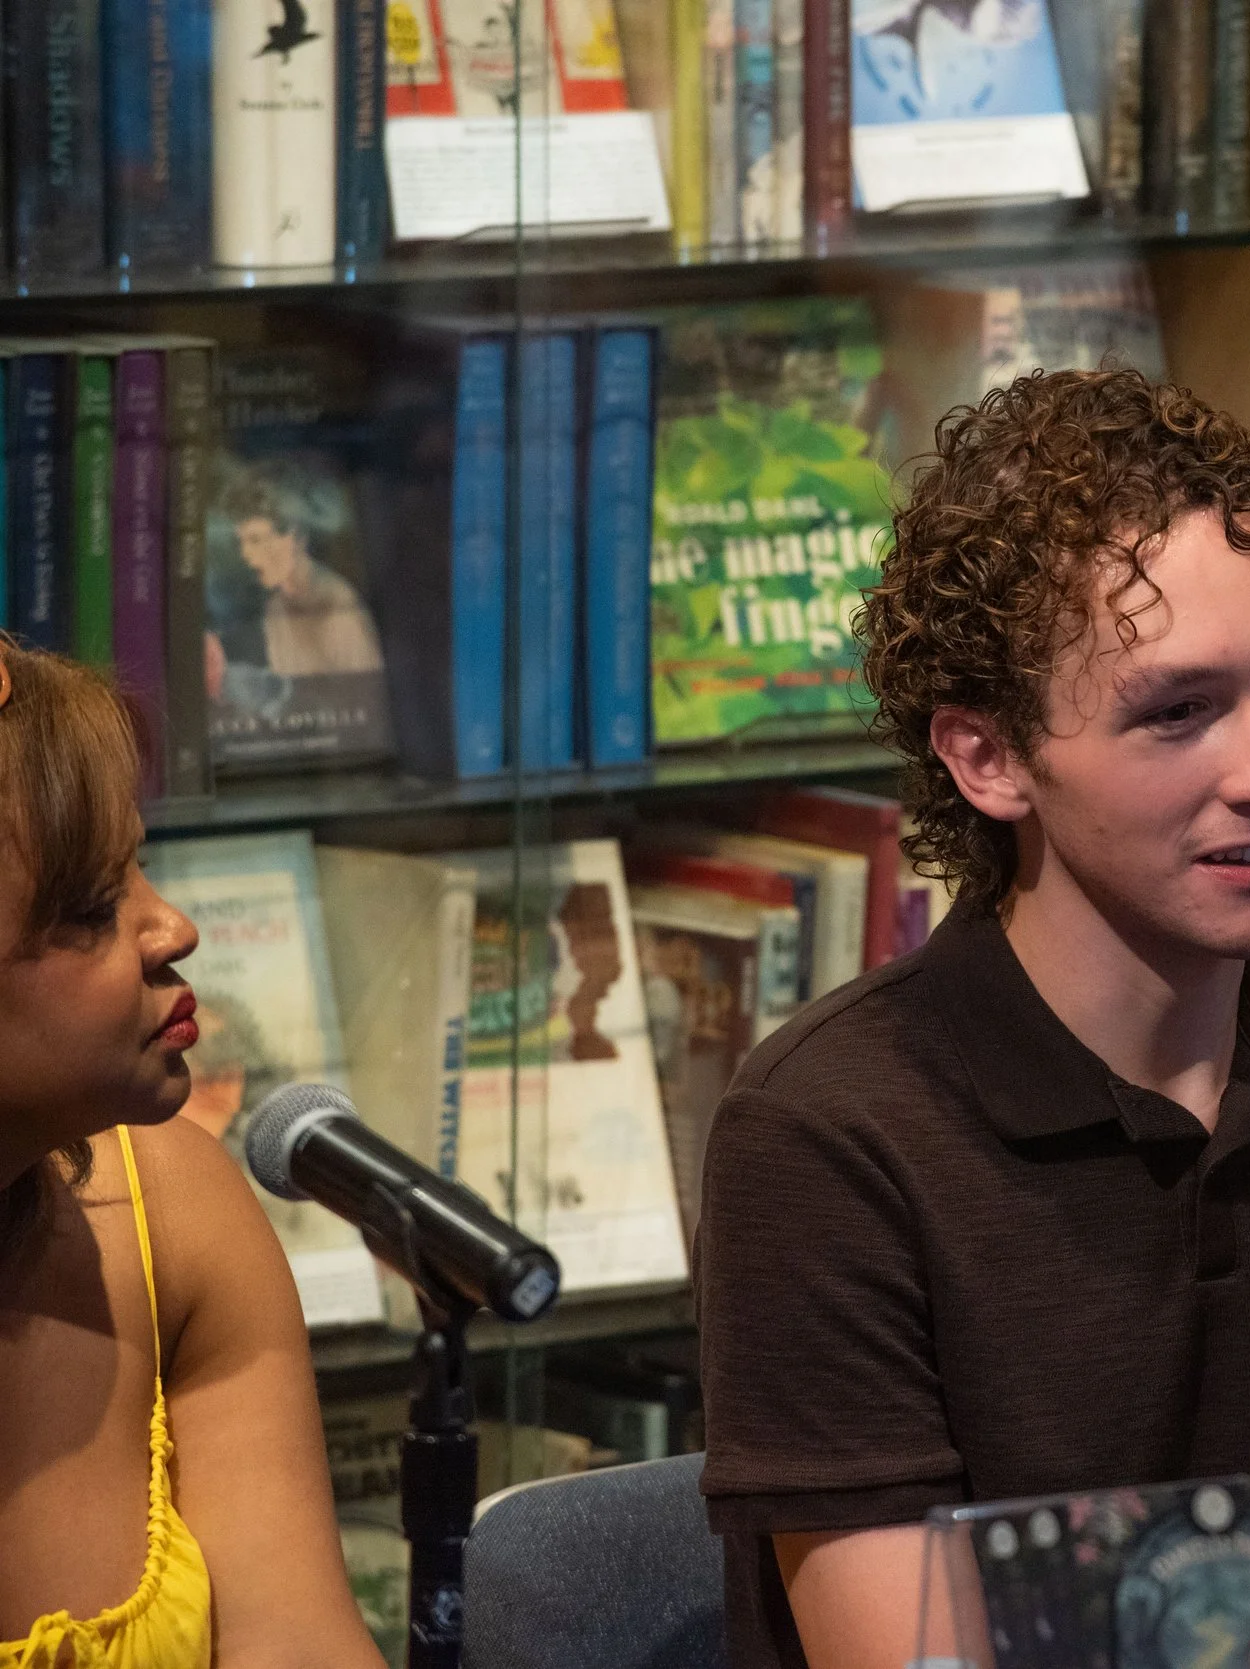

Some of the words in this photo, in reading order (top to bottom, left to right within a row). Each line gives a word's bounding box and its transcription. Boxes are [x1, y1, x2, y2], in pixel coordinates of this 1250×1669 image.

[47, 13, 80, 188] Shadows
[723, 507, 891, 588] magic
[720, 584, 864, 660] finge
[439, 1079, 463, 1182] WITCH
